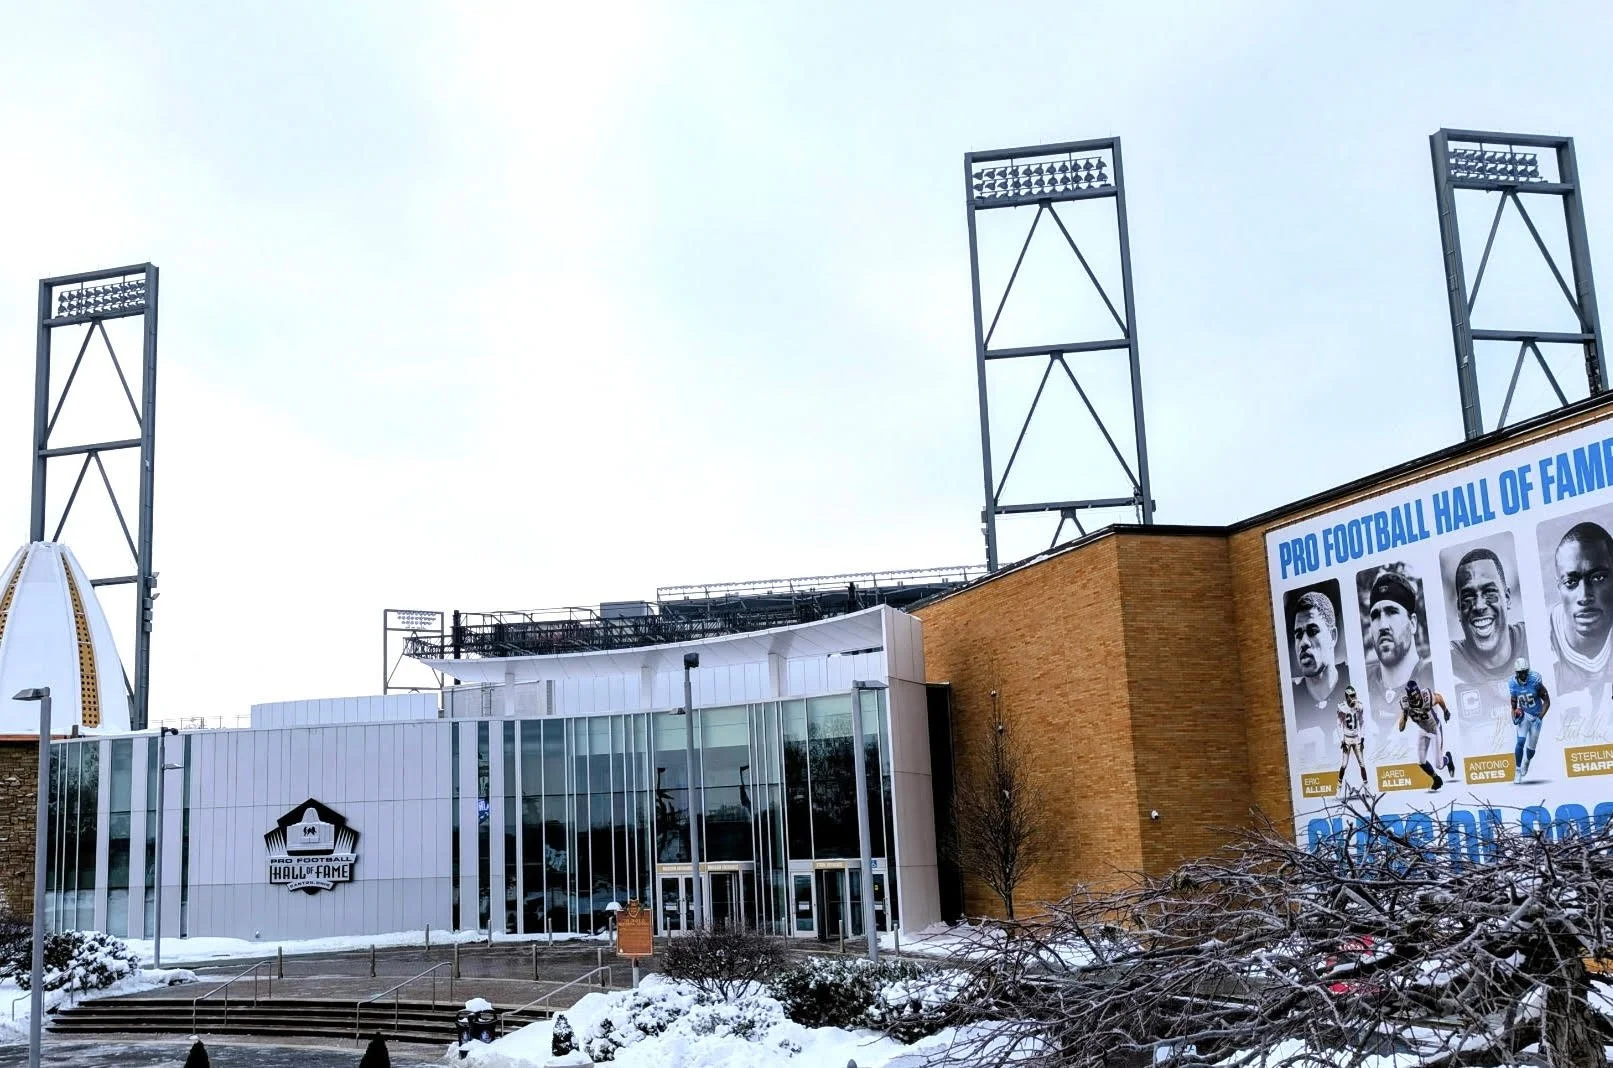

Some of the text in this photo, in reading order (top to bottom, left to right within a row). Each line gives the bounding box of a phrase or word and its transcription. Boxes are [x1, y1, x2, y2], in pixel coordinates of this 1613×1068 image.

[1278, 533, 1320, 580] PRO
[1322, 498, 1431, 568] FOOTBALL
[1432, 478, 1496, 535] HALL
[1498, 464, 1534, 516] OF
[1346, 712, 1357, 730] 21
[1469, 759, 1510, 771] ANTONIO
[1381, 769, 1405, 778] JARED
[1470, 770, 1506, 781] GATES
[1304, 777, 1320, 785] ERIC
[1382, 778, 1412, 788] ALLEN
[1305, 785, 1332, 794] ALLEN
[273, 864, 349, 880] HALL OF FAME
